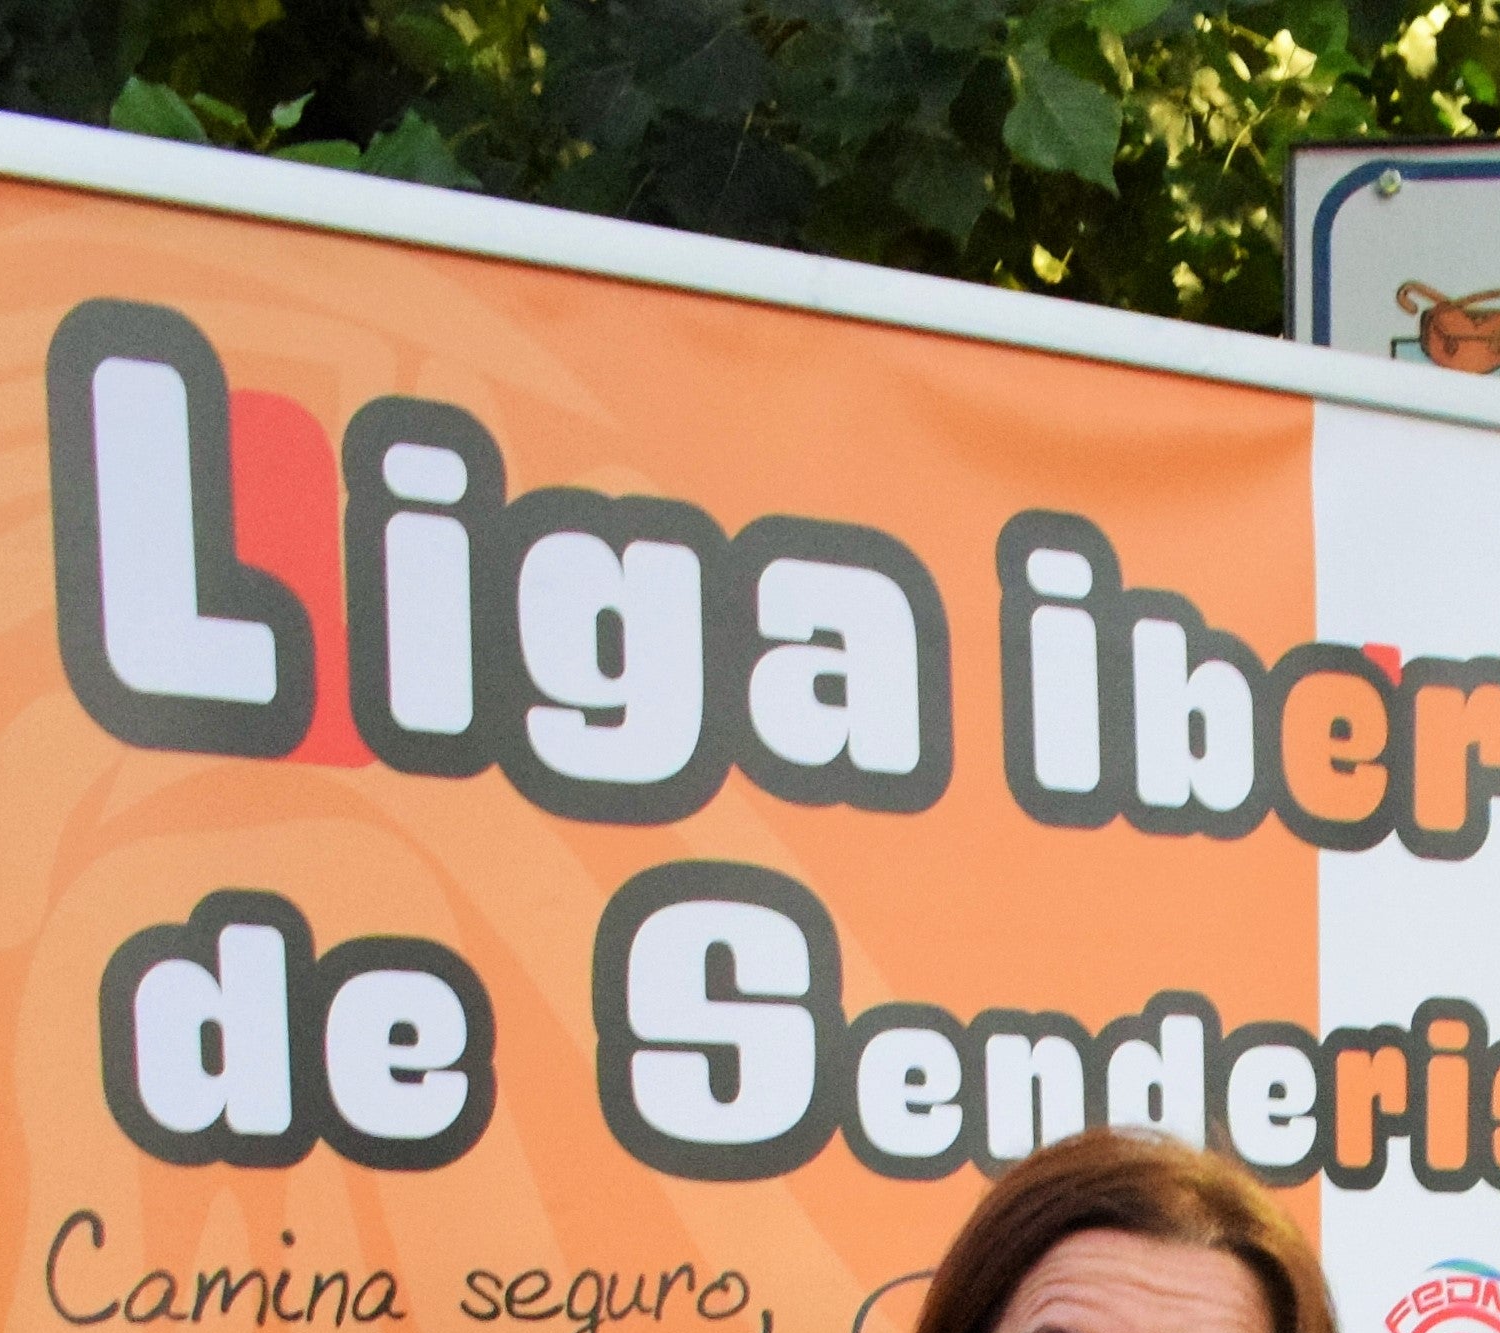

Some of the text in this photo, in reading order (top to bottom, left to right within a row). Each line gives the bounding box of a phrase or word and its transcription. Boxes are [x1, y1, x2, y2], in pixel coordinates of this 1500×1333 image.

[47, 299, 954, 825] Liga
[100, 889, 496, 1170] de
[45, 1209, 406, 1326] Camina
